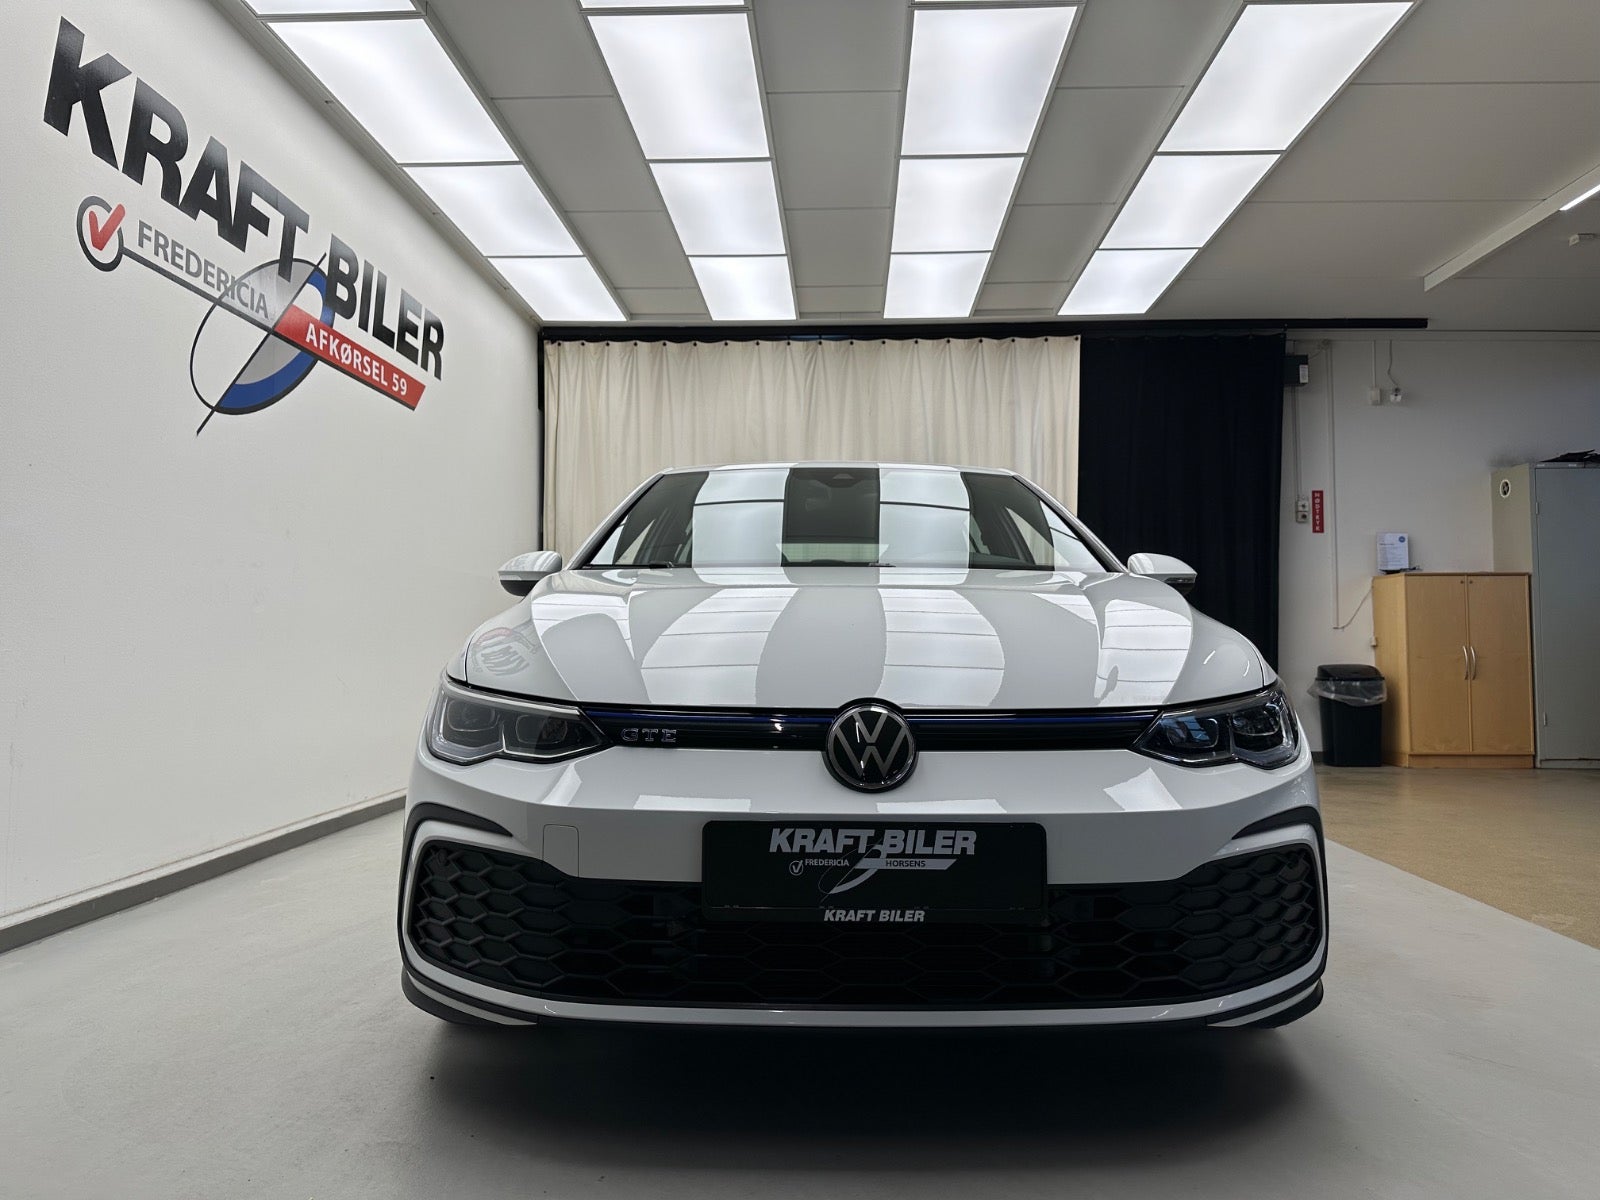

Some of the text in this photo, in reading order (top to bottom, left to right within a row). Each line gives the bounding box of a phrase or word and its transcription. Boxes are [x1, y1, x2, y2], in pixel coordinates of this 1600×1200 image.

[44, 16, 444, 381] KRAFT BILER
[137, 219, 269, 320] FREDERICIA
[305, 323, 408, 396] AFKØRSEL 59
[621, 727, 677, 742] GTE
[833, 709, 908, 778] VW
[769, 828, 977, 855] KRAFT BILER
[804, 858, 850, 867] FREDERICIA
[885, 859, 926, 868] HORSENS
[823, 909, 926, 922] KRAFT BILER
